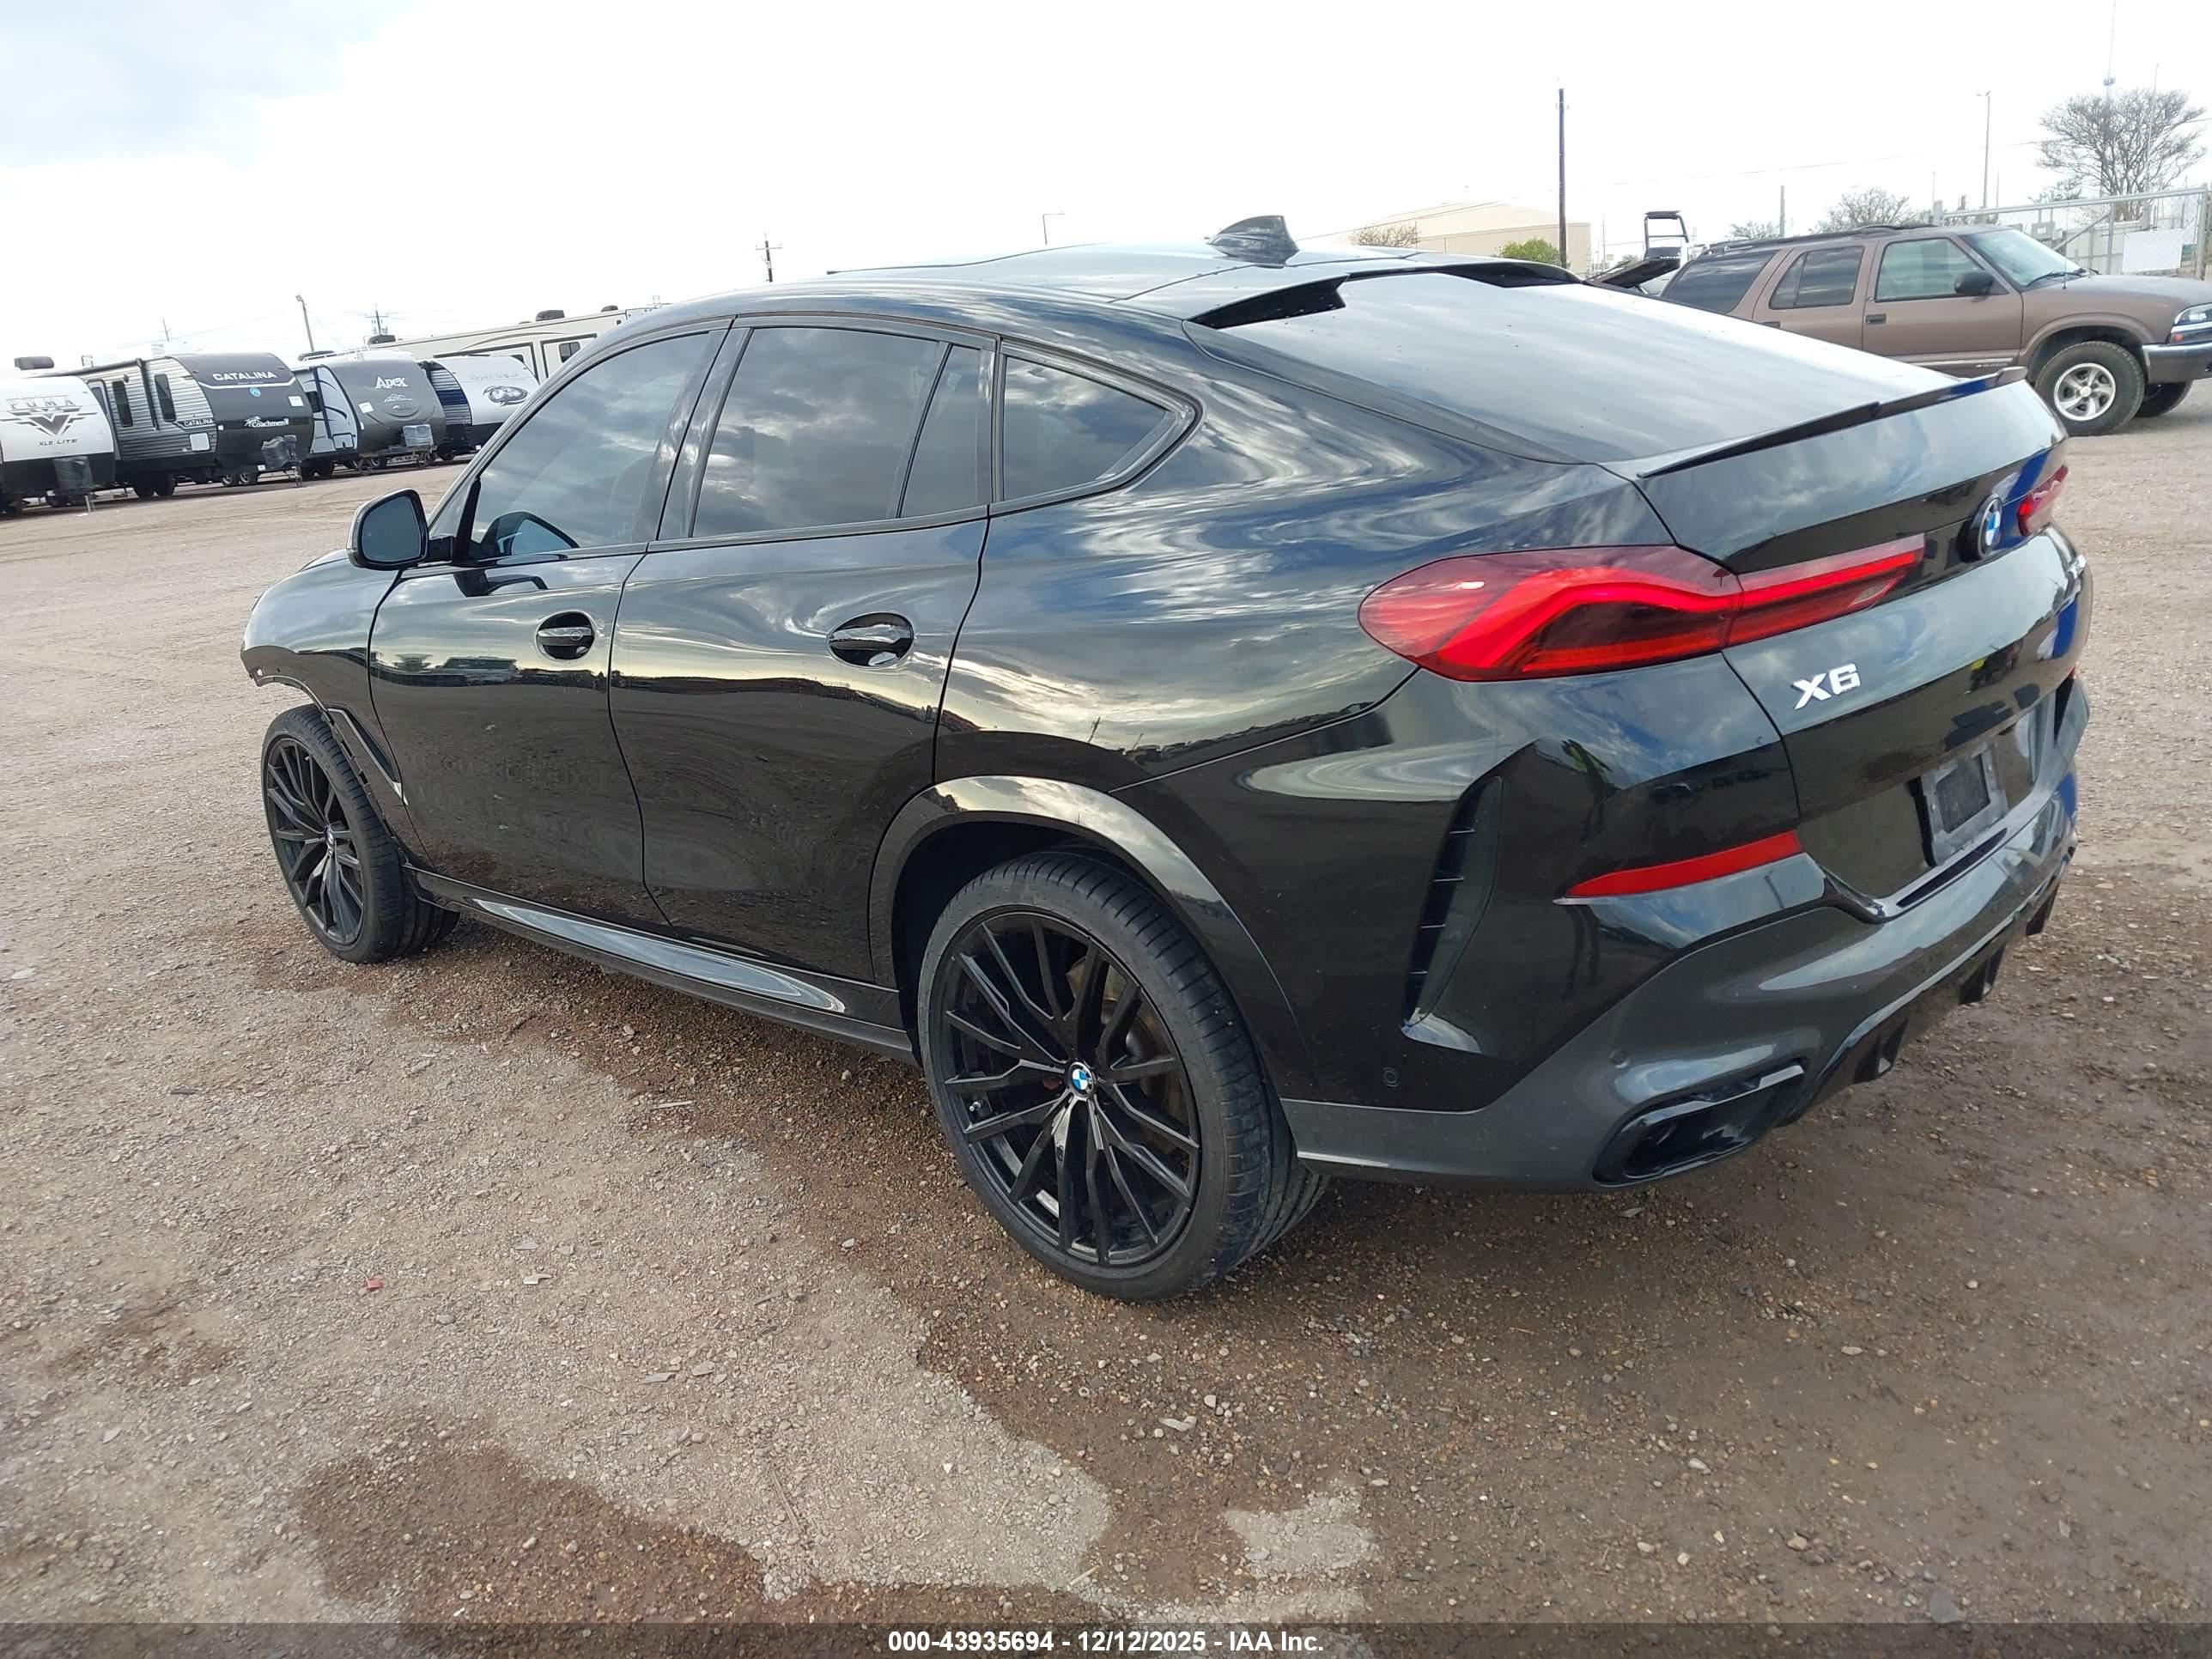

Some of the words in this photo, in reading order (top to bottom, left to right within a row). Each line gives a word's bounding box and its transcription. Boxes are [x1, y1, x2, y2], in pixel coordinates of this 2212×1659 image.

[212, 371, 277, 380] CATALINA
[375, 376, 409, 389] Apex
[184, 418, 214, 427] CATALINA
[252, 419, 284, 428] Coachmen
[1791, 663, 1861, 711] X6
